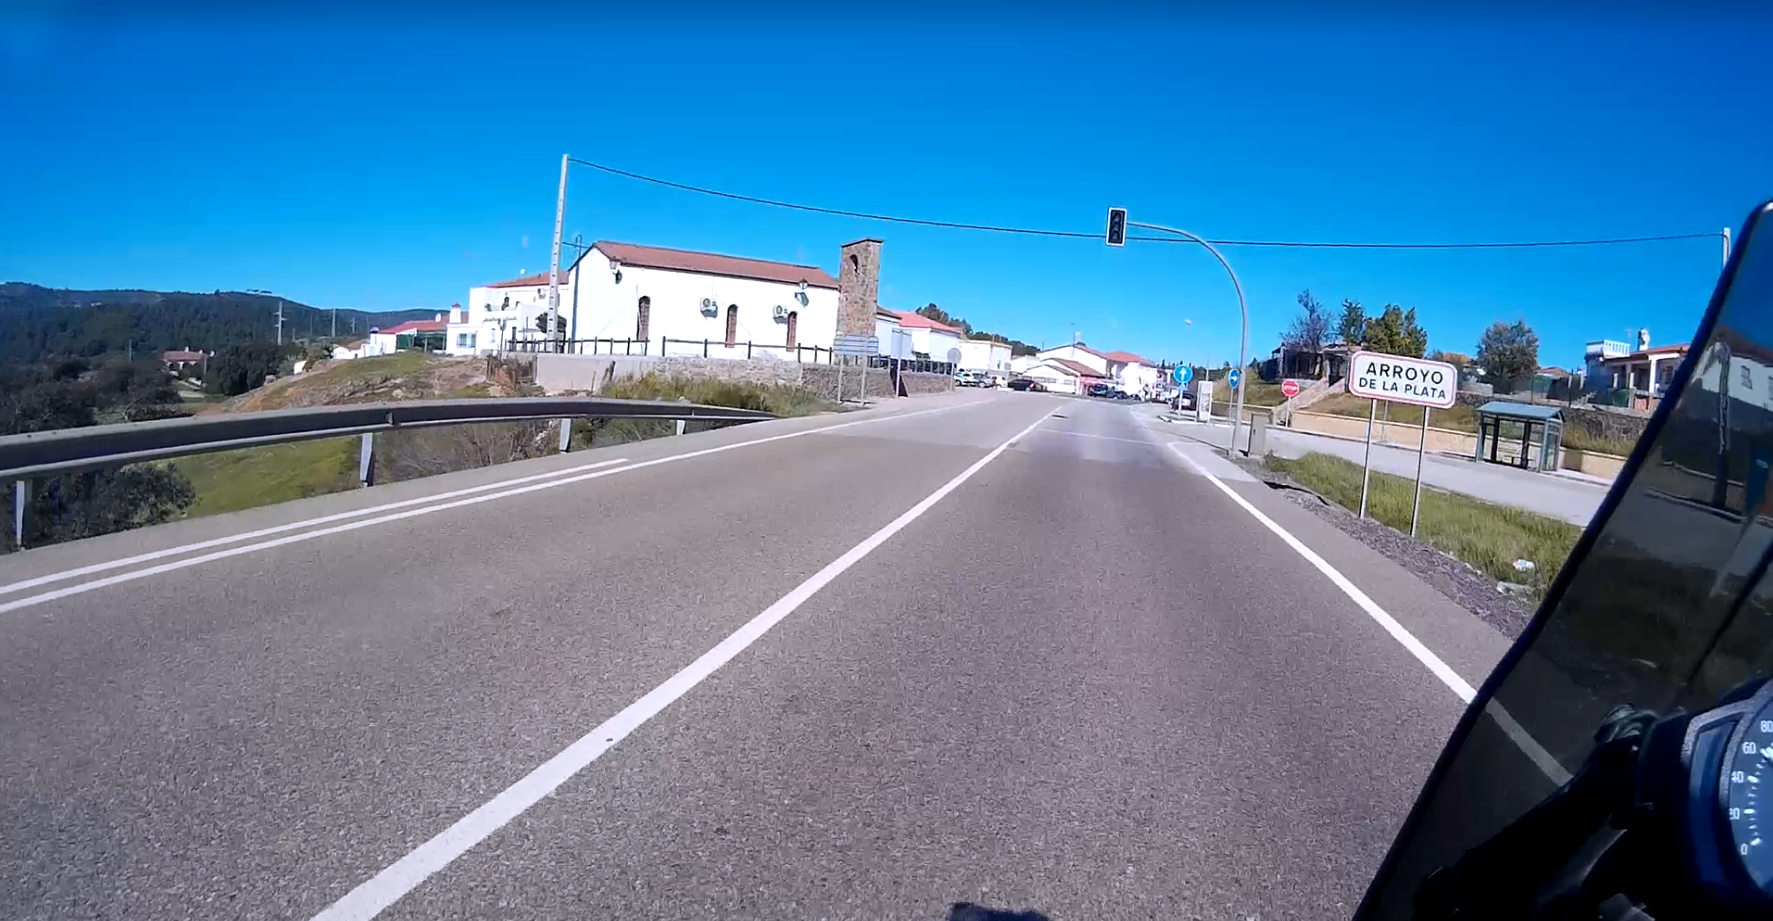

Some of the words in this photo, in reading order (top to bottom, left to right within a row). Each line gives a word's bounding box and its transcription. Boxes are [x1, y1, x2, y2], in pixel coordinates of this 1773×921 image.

[1366, 362, 1443, 385] ARROYO
[1359, 377, 1377, 389] DE
[1382, 381, 1398, 392] LA
[1404, 384, 1446, 399] PLATA
[1760, 720, 1773, 733] 80
[1742, 741, 1756, 755] 60
[1731, 771, 1744, 783] 40
[1740, 843, 1748, 855] 0
